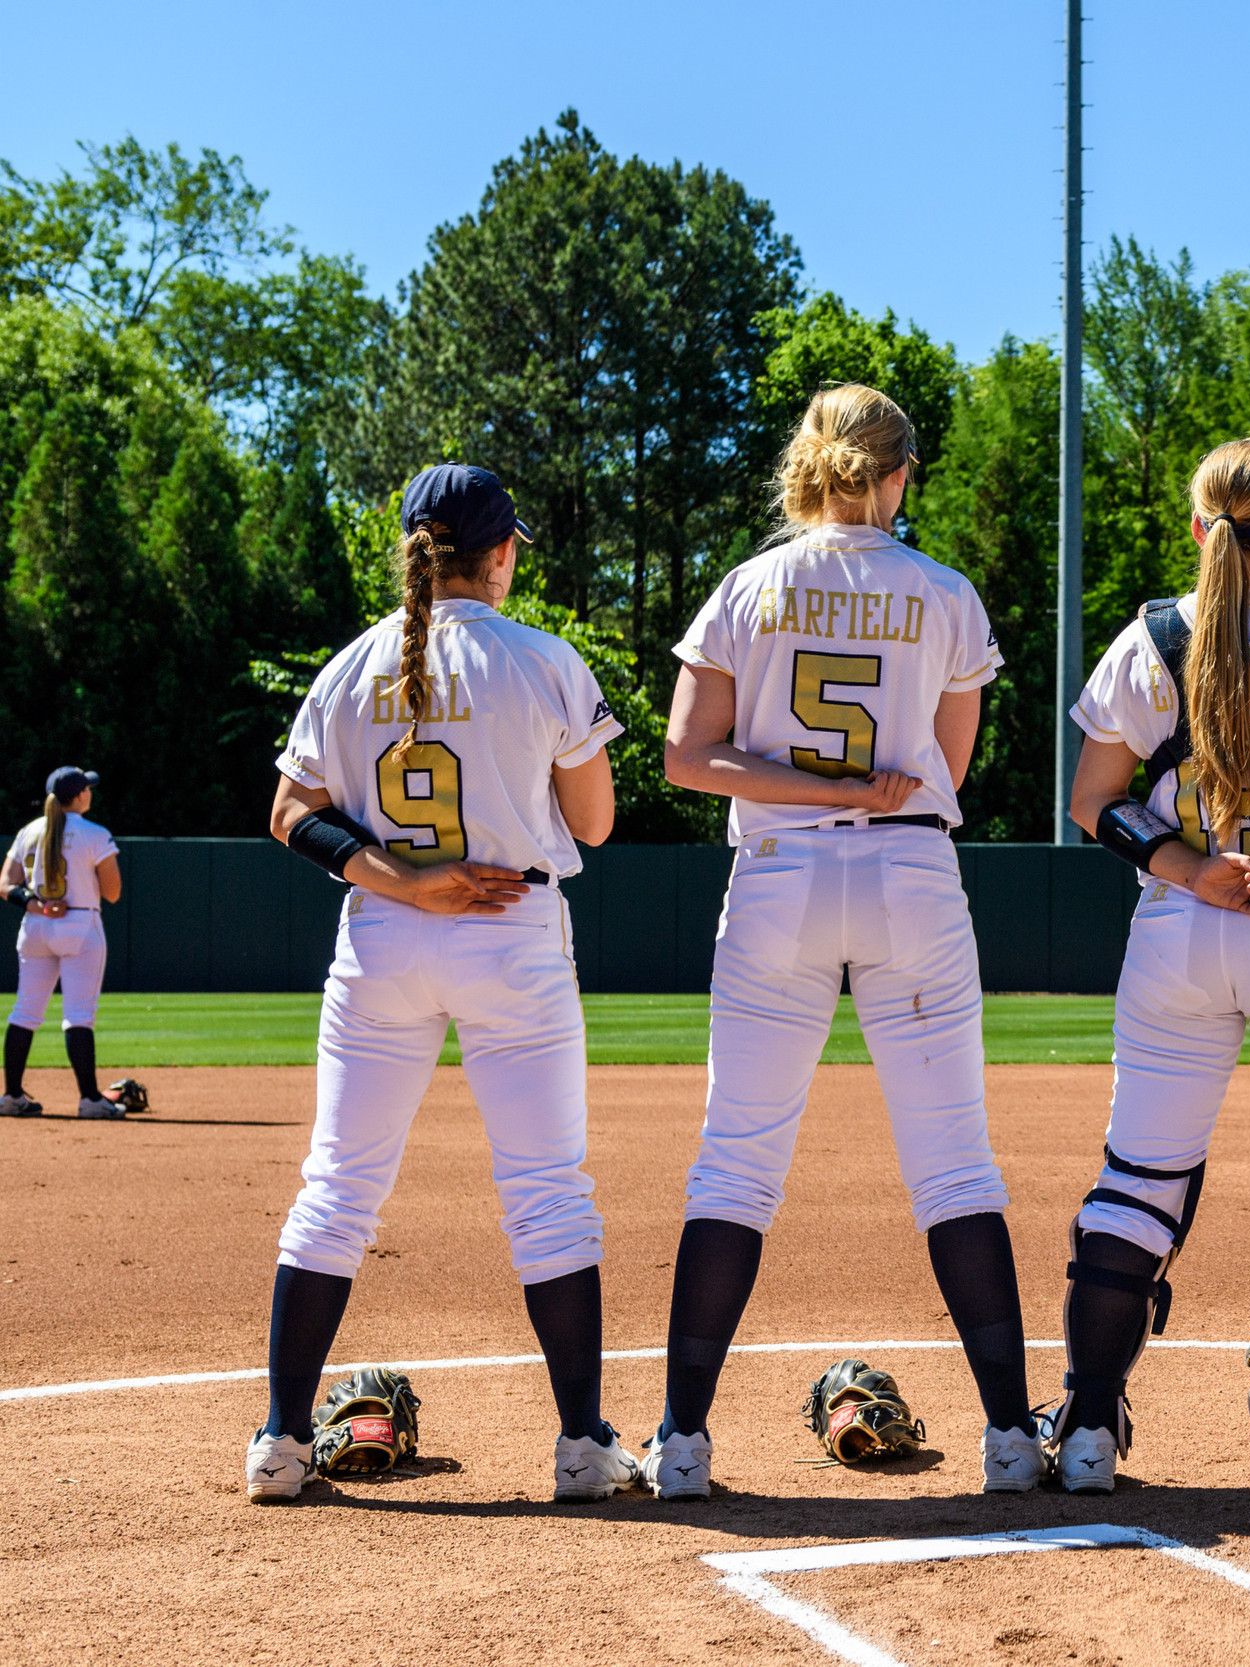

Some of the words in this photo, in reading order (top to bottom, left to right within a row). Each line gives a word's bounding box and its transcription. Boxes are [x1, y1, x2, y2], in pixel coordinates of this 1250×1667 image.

[759, 585, 925, 645] BARFIELD
[789, 648, 882, 780] 5
[375, 740, 469, 869] 9
